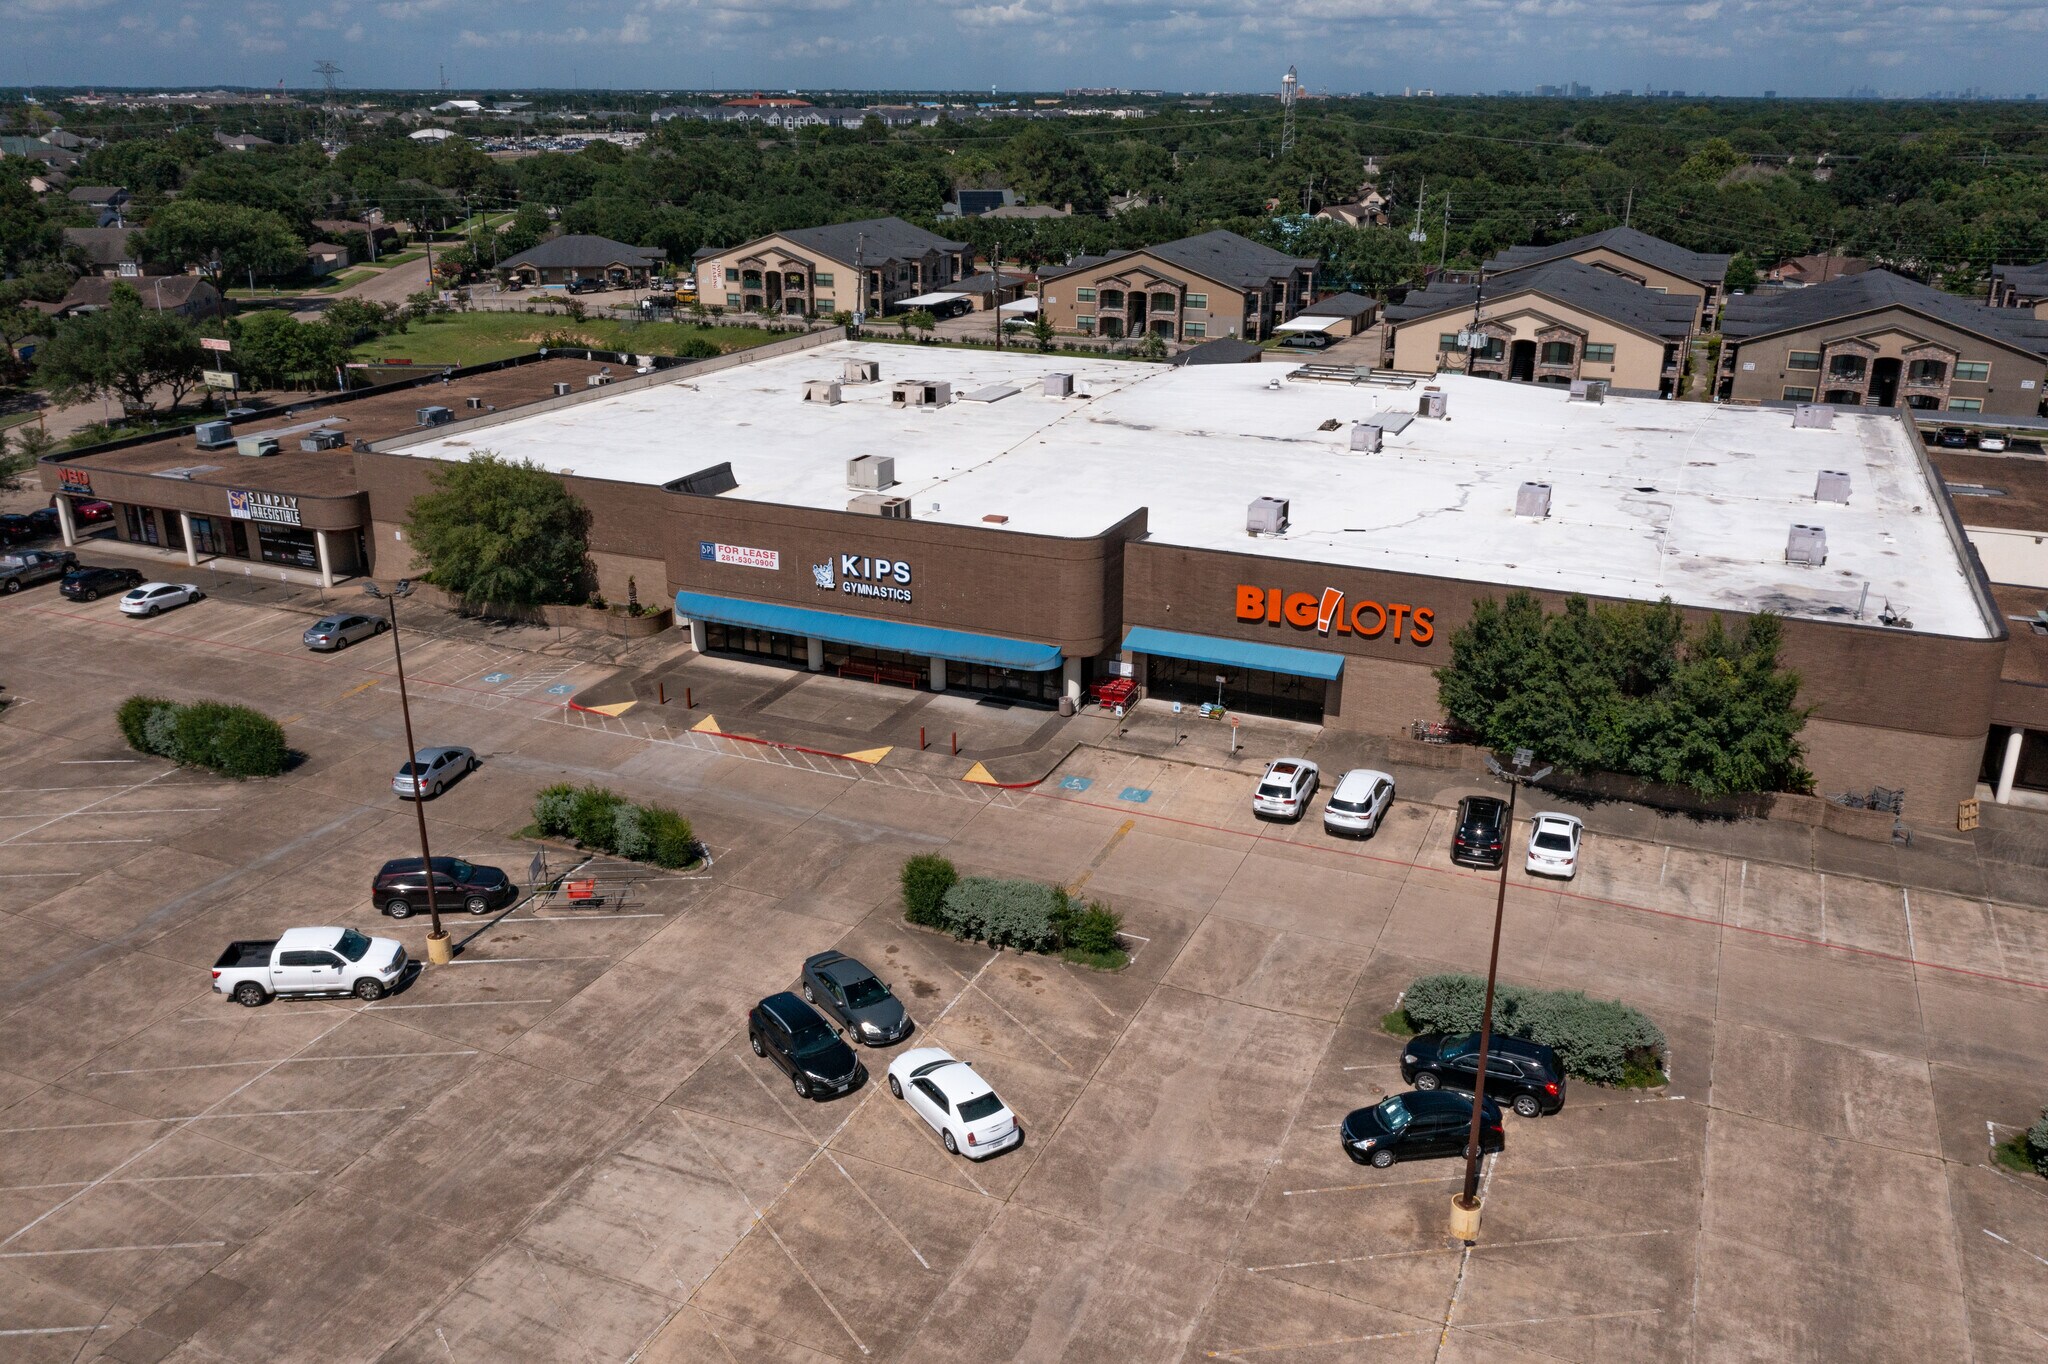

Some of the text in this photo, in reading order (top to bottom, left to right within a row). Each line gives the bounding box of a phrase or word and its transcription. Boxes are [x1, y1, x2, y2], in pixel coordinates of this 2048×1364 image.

[248, 492, 297, 509] SIMPLY
[249, 505, 301, 523] IRRESISTIBLE
[718, 545, 776, 560] FOR LEASE
[721, 554, 774, 567] 281-530-0900
[841, 554, 912, 584] KIPS
[842, 581, 912, 602] GYMNASTICS
